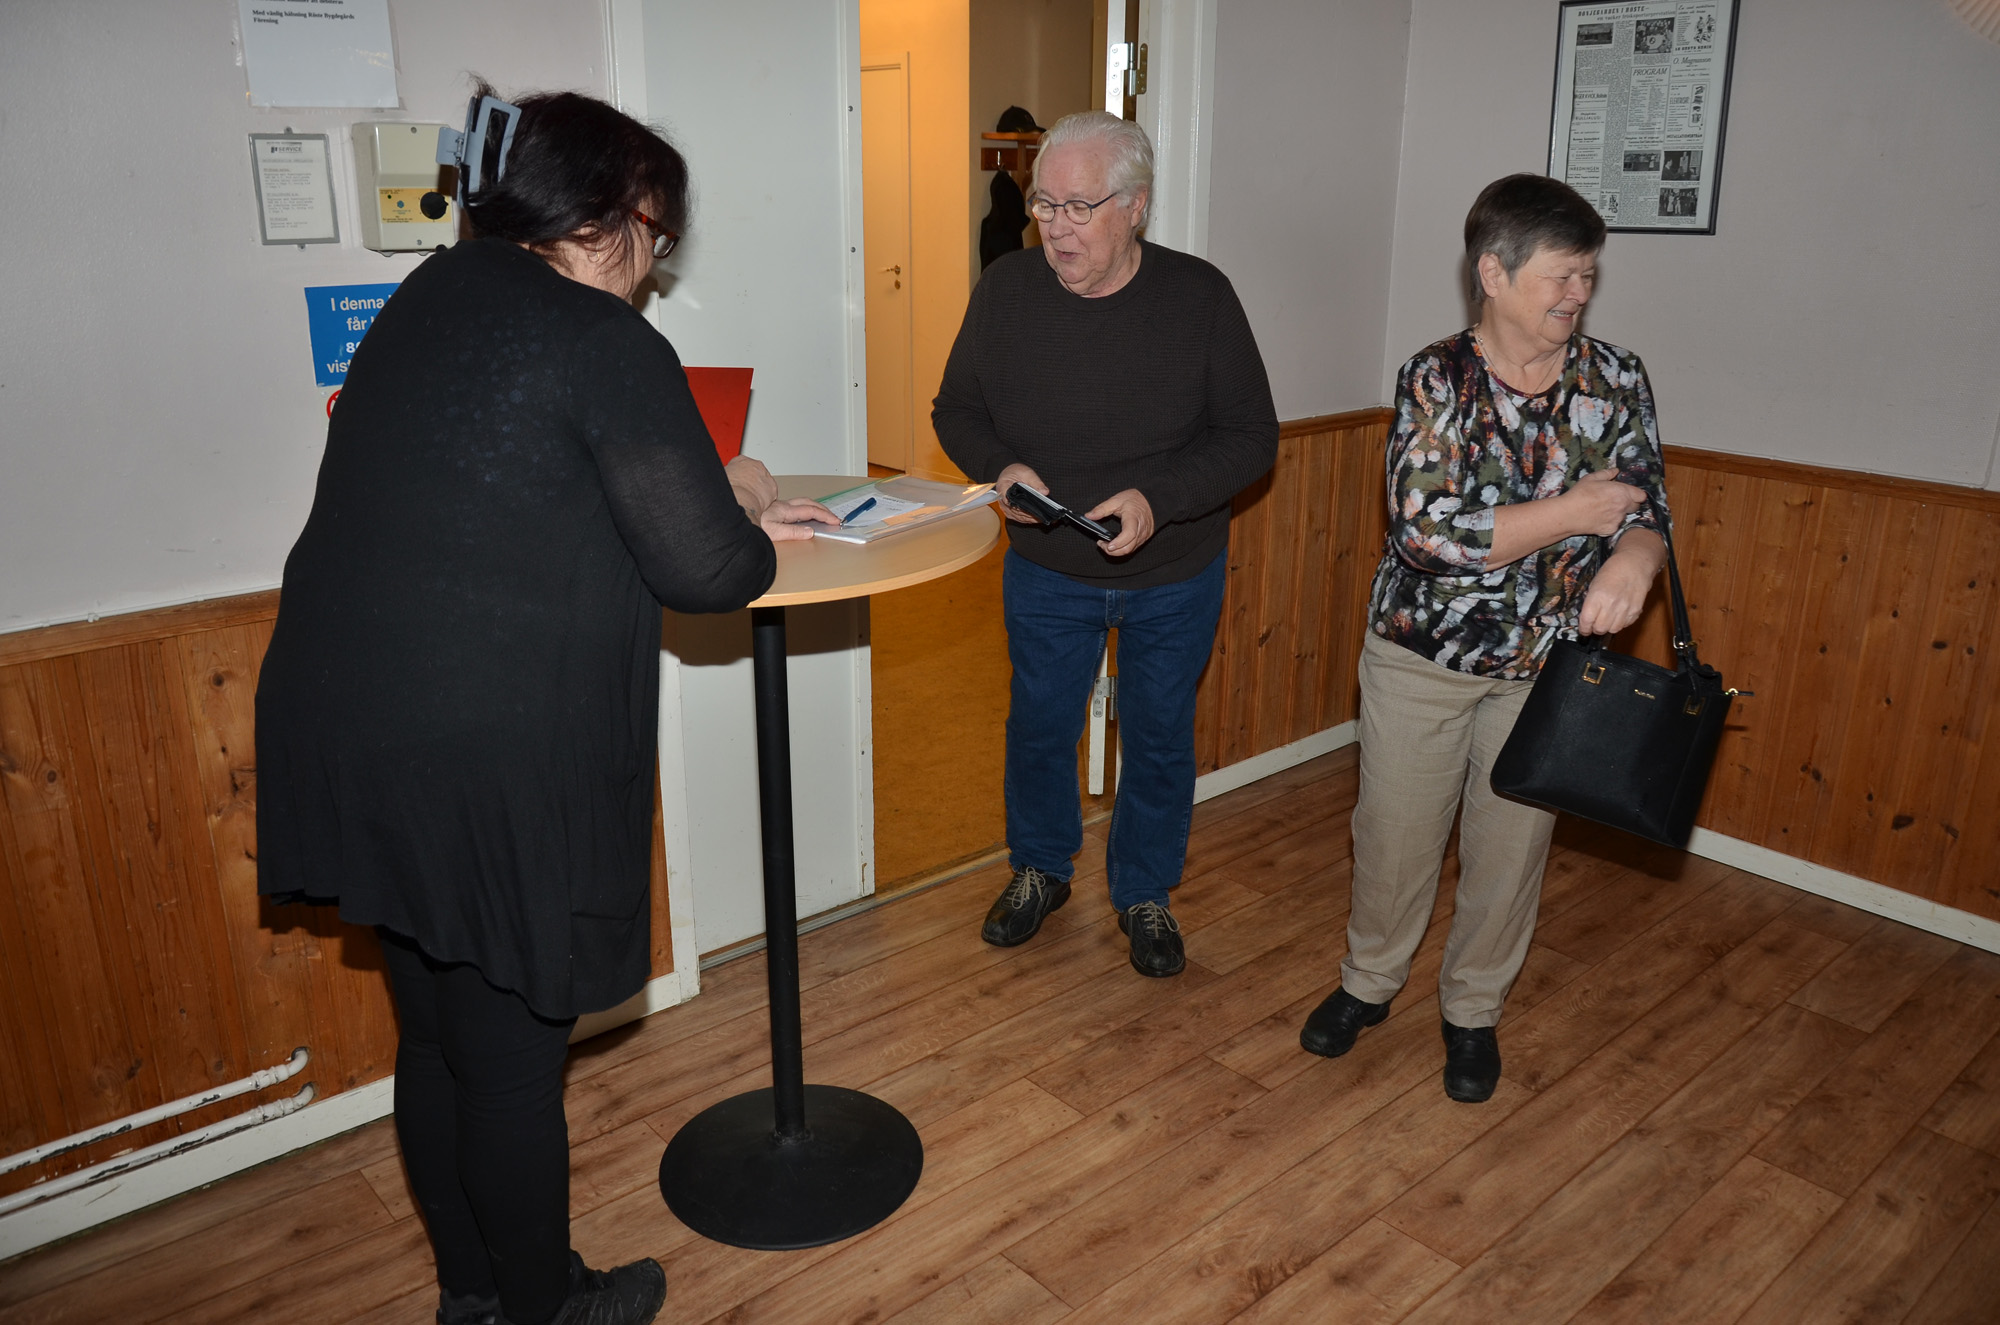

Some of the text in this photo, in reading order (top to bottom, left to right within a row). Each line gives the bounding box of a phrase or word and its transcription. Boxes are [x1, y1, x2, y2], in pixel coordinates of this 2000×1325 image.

[1632, 67, 1668, 76] PROGRAM
[330, 297, 384, 311] I denna
[346, 316, 367, 331] får
